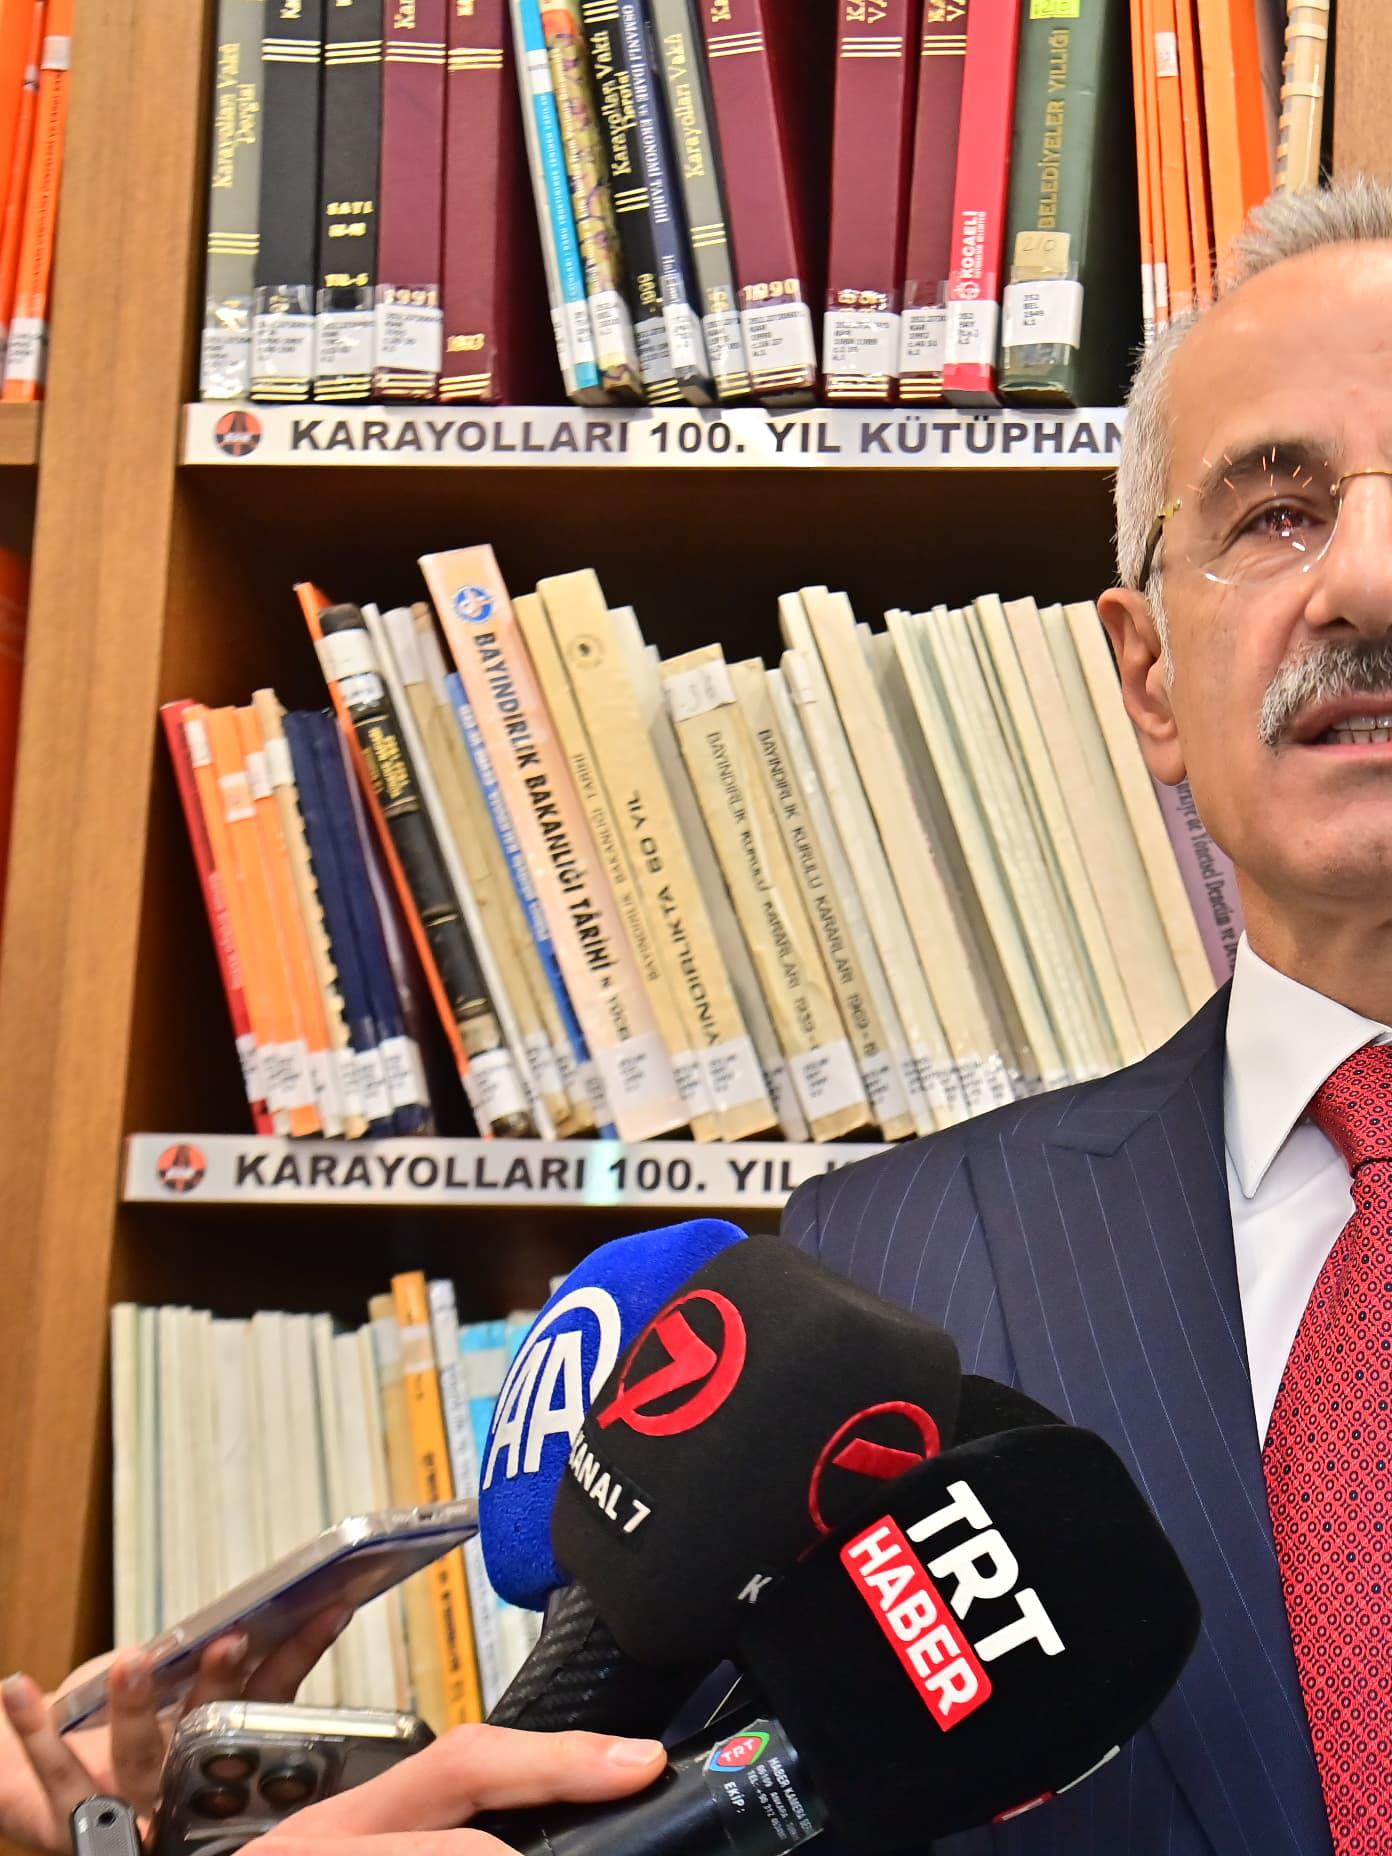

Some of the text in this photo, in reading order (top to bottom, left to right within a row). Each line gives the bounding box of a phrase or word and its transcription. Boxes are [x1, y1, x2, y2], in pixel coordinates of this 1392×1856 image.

[1048, 27, 1071, 96] YILLIĞI
[1037, 99, 1065, 229] BELEDİYELER
[960, 210, 979, 279] KOCAELİ
[291, 414, 1124, 454] KARAYOLLARI 100. YIL KÜTÜPHAN
[475, 632, 539, 768] BAYINDIRLIK
[524, 774, 587, 893] BAKANLIĞI
[757, 728, 799, 819] BAYINDIRLIK
[658, 884, 719, 1046] YINDIRLIKTA
[234, 1154, 799, 1194] KARAYOLLARI 100. YIL
[623, 1500, 651, 1533] 7
[906, 1480, 1065, 1662] TRT
[847, 1525, 979, 1717] HABER
[721, 1739, 755, 1762] TRT
